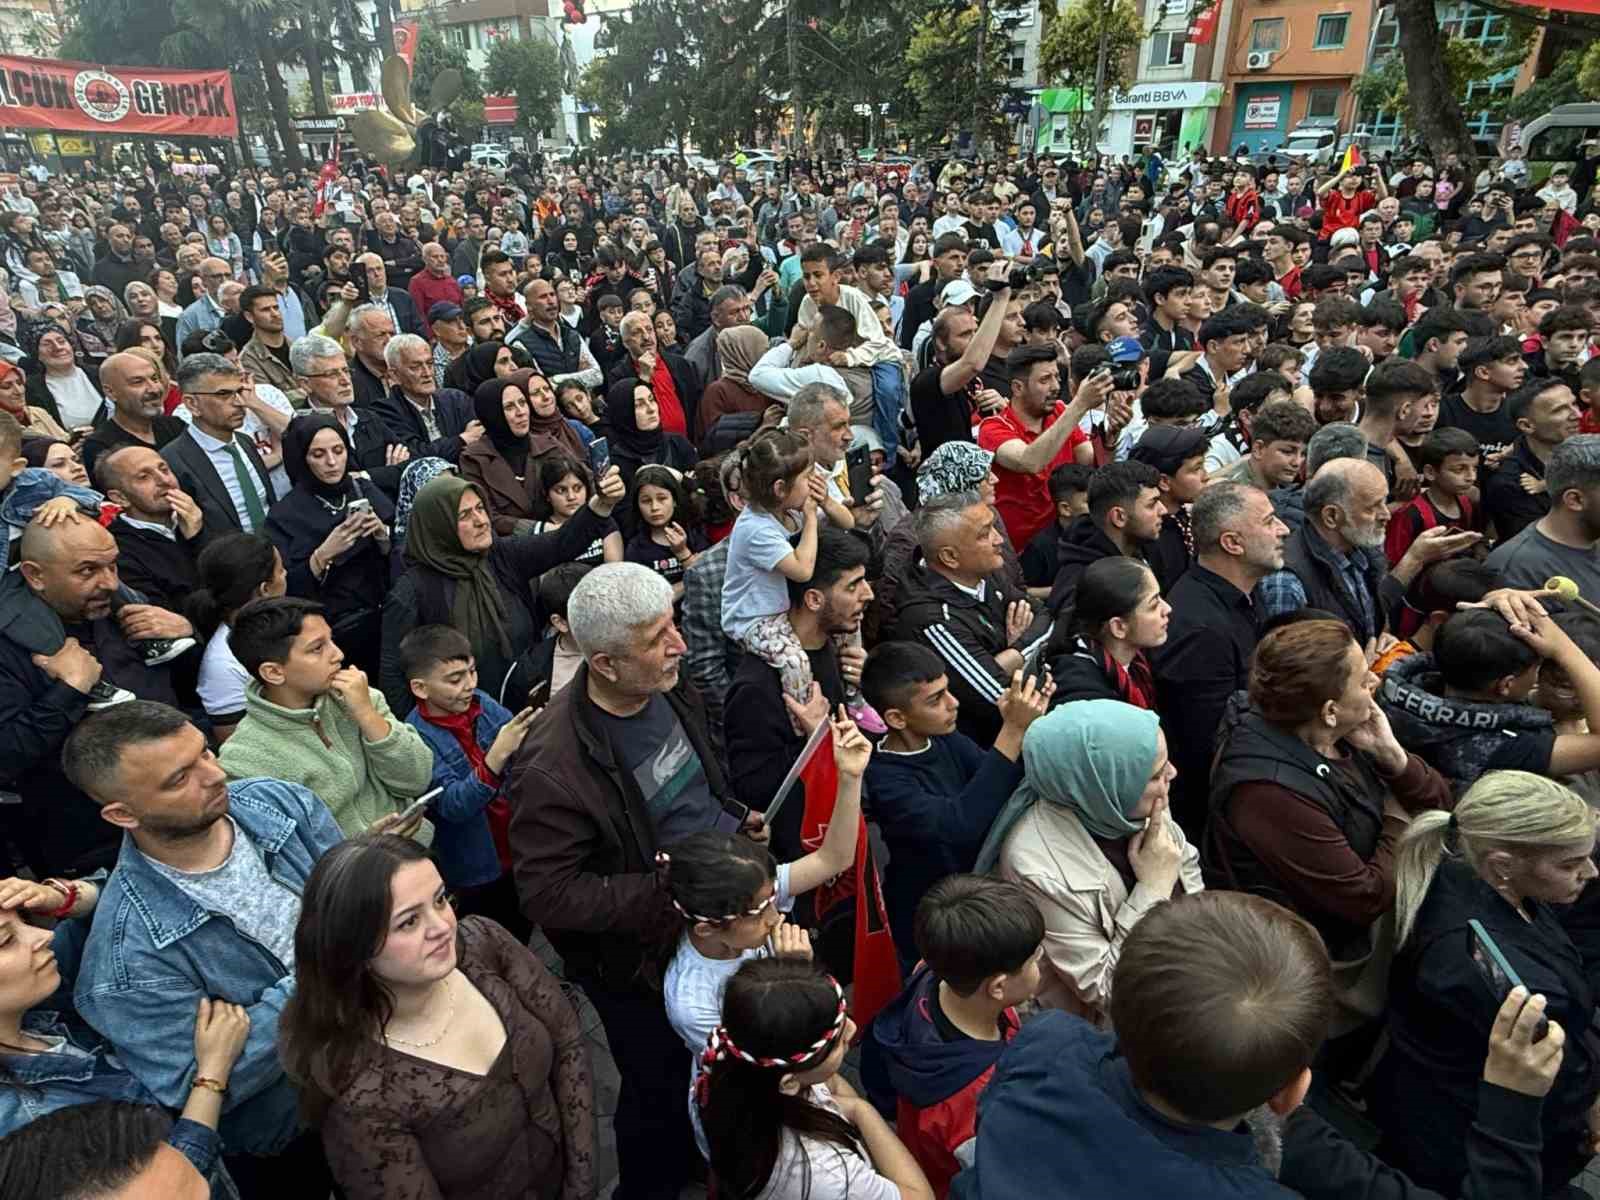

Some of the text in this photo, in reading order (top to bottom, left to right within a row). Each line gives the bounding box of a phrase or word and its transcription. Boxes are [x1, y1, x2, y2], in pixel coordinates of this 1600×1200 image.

[0, 65, 230, 120] LCÜK GENÇLİK
[1115, 89, 1187, 103] Garanti BBVA
[1393, 686, 1500, 729] FERRARI
